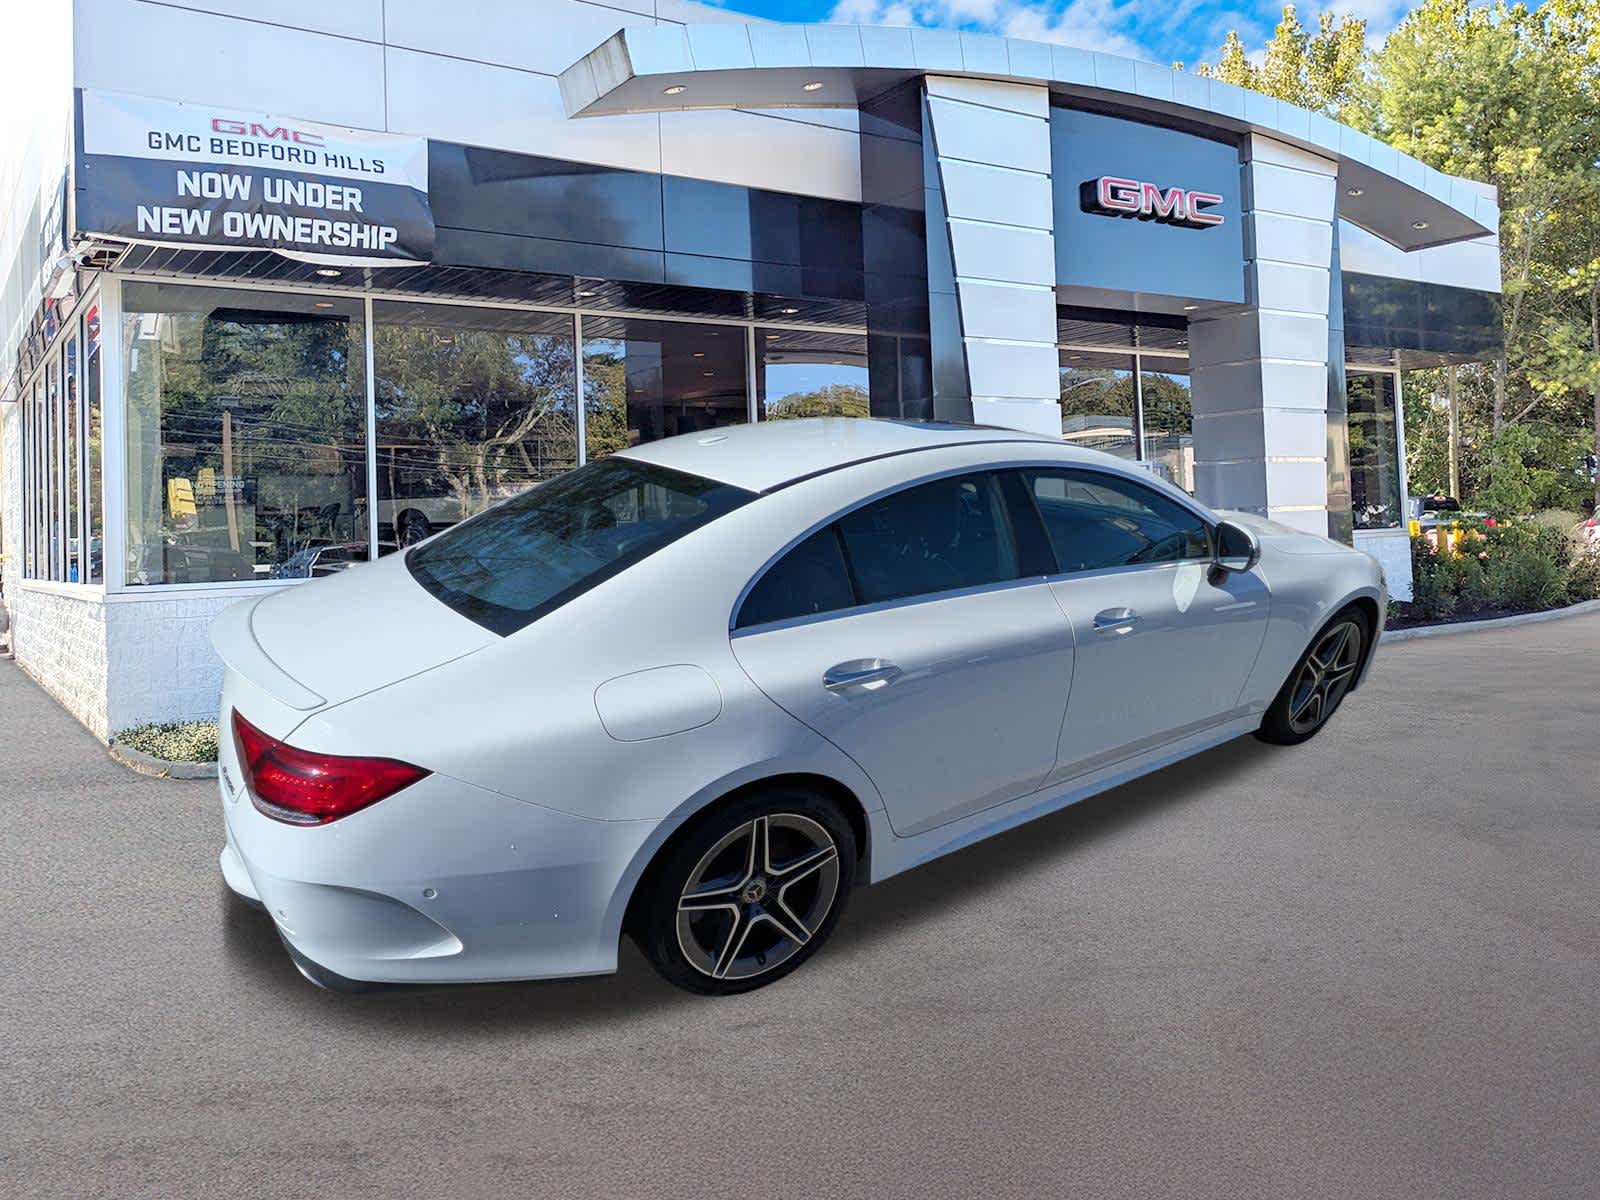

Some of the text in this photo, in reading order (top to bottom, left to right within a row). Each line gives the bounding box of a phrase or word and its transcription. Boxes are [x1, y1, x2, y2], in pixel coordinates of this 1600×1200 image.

[148, 131, 385, 173] GMC BEDFORD HILLS
[211, 118, 326, 147] GMC
[177, 171, 364, 212] NOW UNDER
[1096, 176, 1225, 227] GMC
[137, 206, 398, 250] NEW OWNERSHIP
